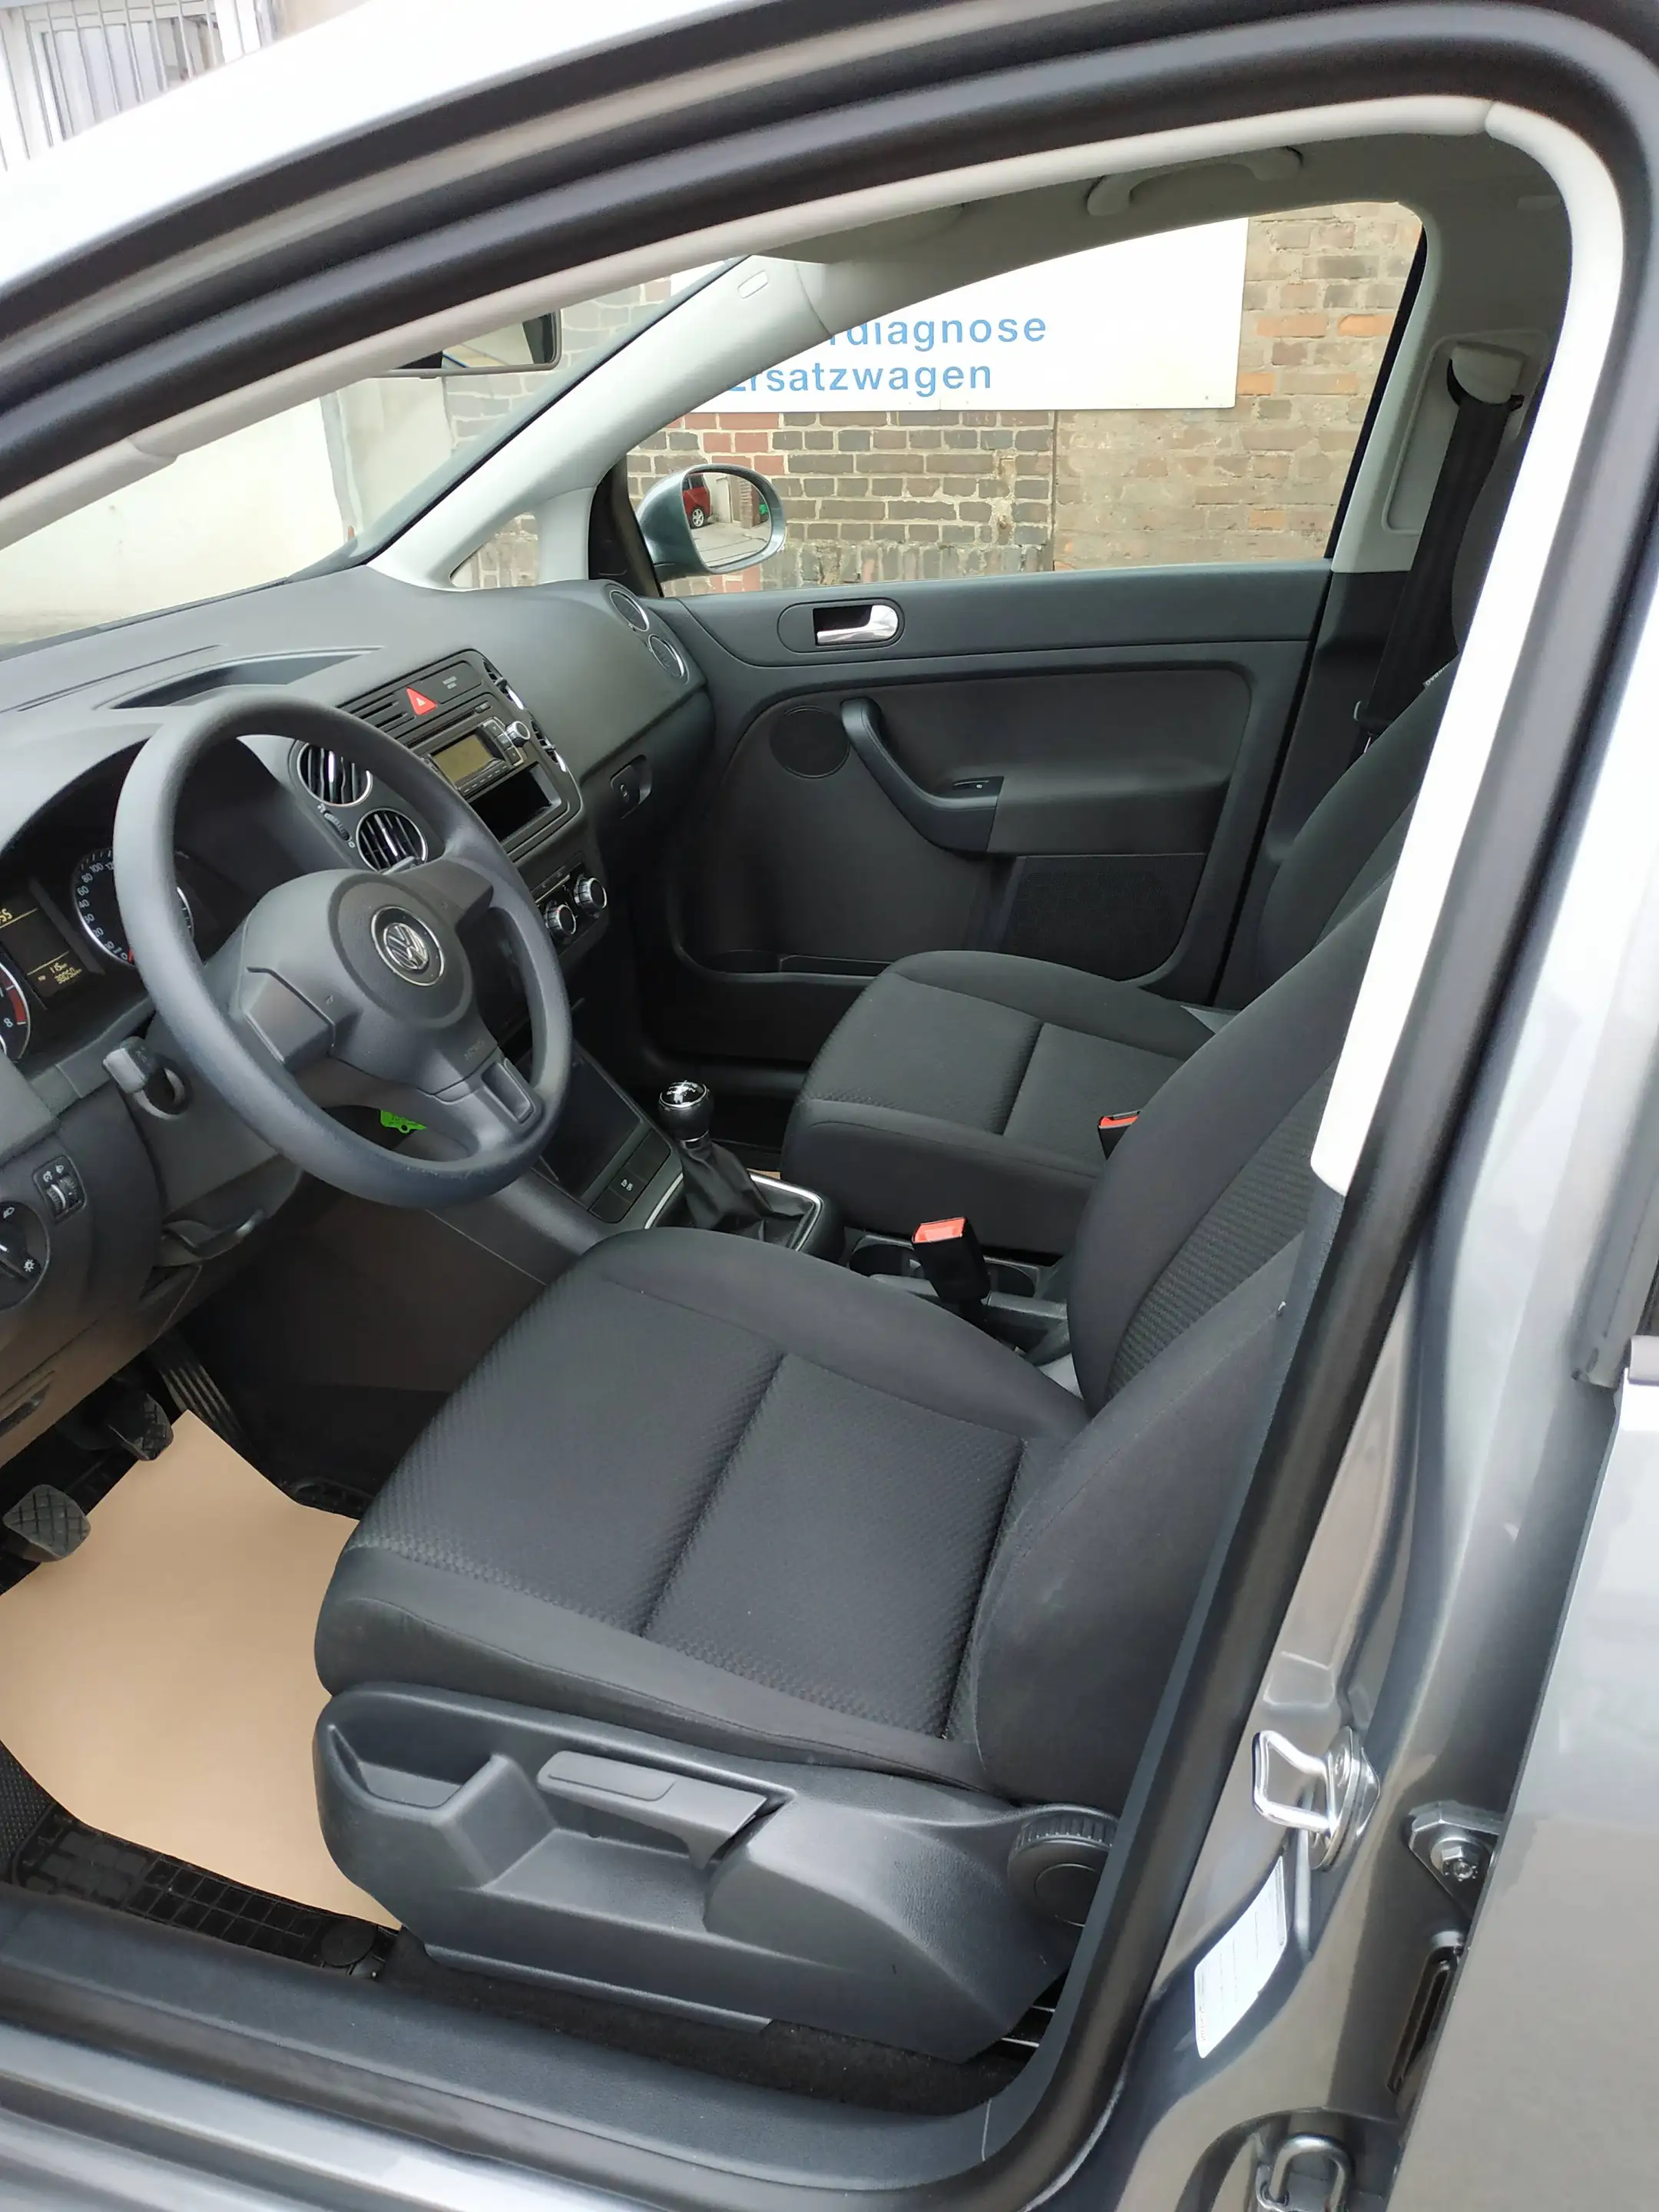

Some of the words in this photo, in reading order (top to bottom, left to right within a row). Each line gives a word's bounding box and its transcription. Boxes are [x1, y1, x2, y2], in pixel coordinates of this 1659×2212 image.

[730, 363, 990, 397] rsatzwagen
[77, 886, 89, 896] 60
[3, 1018, 13, 1028] 8
